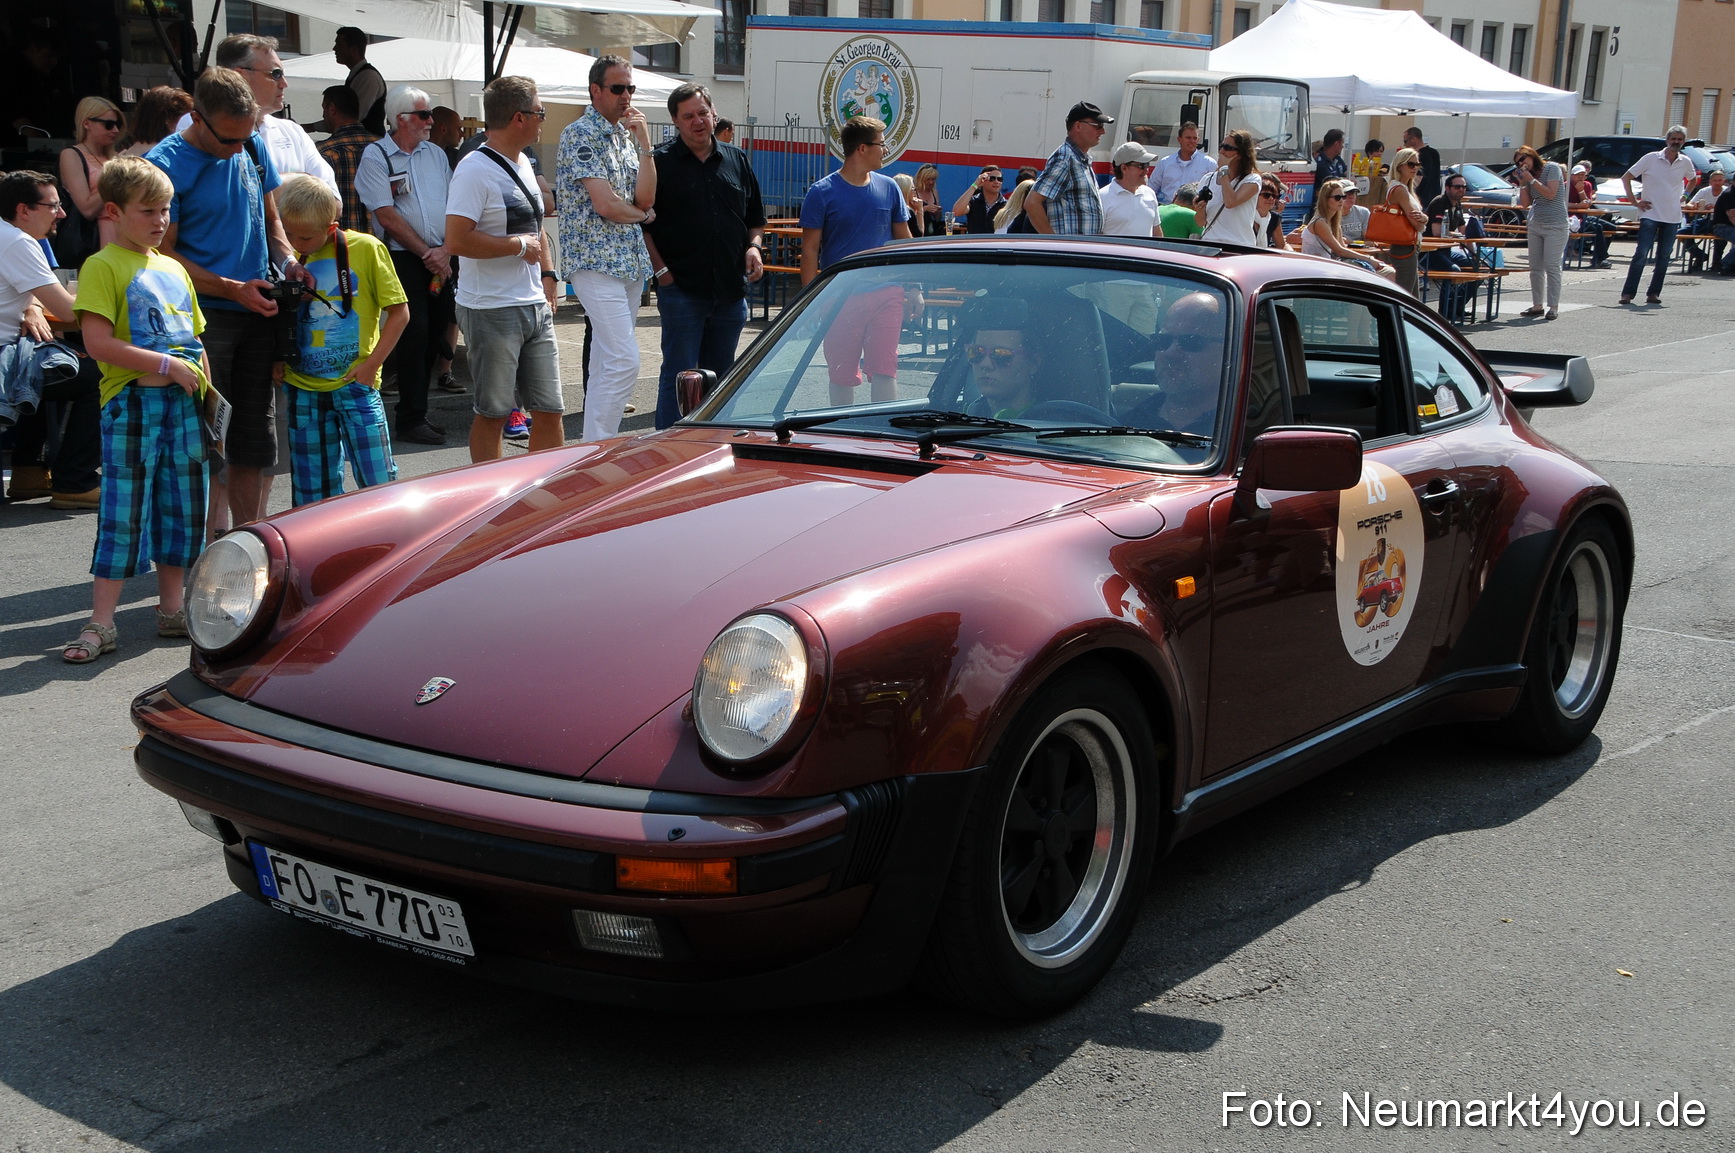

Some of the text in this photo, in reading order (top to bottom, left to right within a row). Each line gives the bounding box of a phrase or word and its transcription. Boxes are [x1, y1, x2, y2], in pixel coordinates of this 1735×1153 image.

[1610, 26, 1620, 56] 5
[834, 42, 902, 69] St. Georgen Bräu
[784, 113, 800, 127] Seit
[940, 125, 960, 140] 1624
[341, 269, 349, 294] Canon
[1357, 509, 1403, 531] PORSCHE
[1375, 523, 1388, 536] 911
[1366, 620, 1390, 634] JAHRE
[263, 874, 271, 887] D
[270, 854, 440, 941] FO E 770
[438, 903, 455, 918] 03
[448, 933, 464, 947] 10
